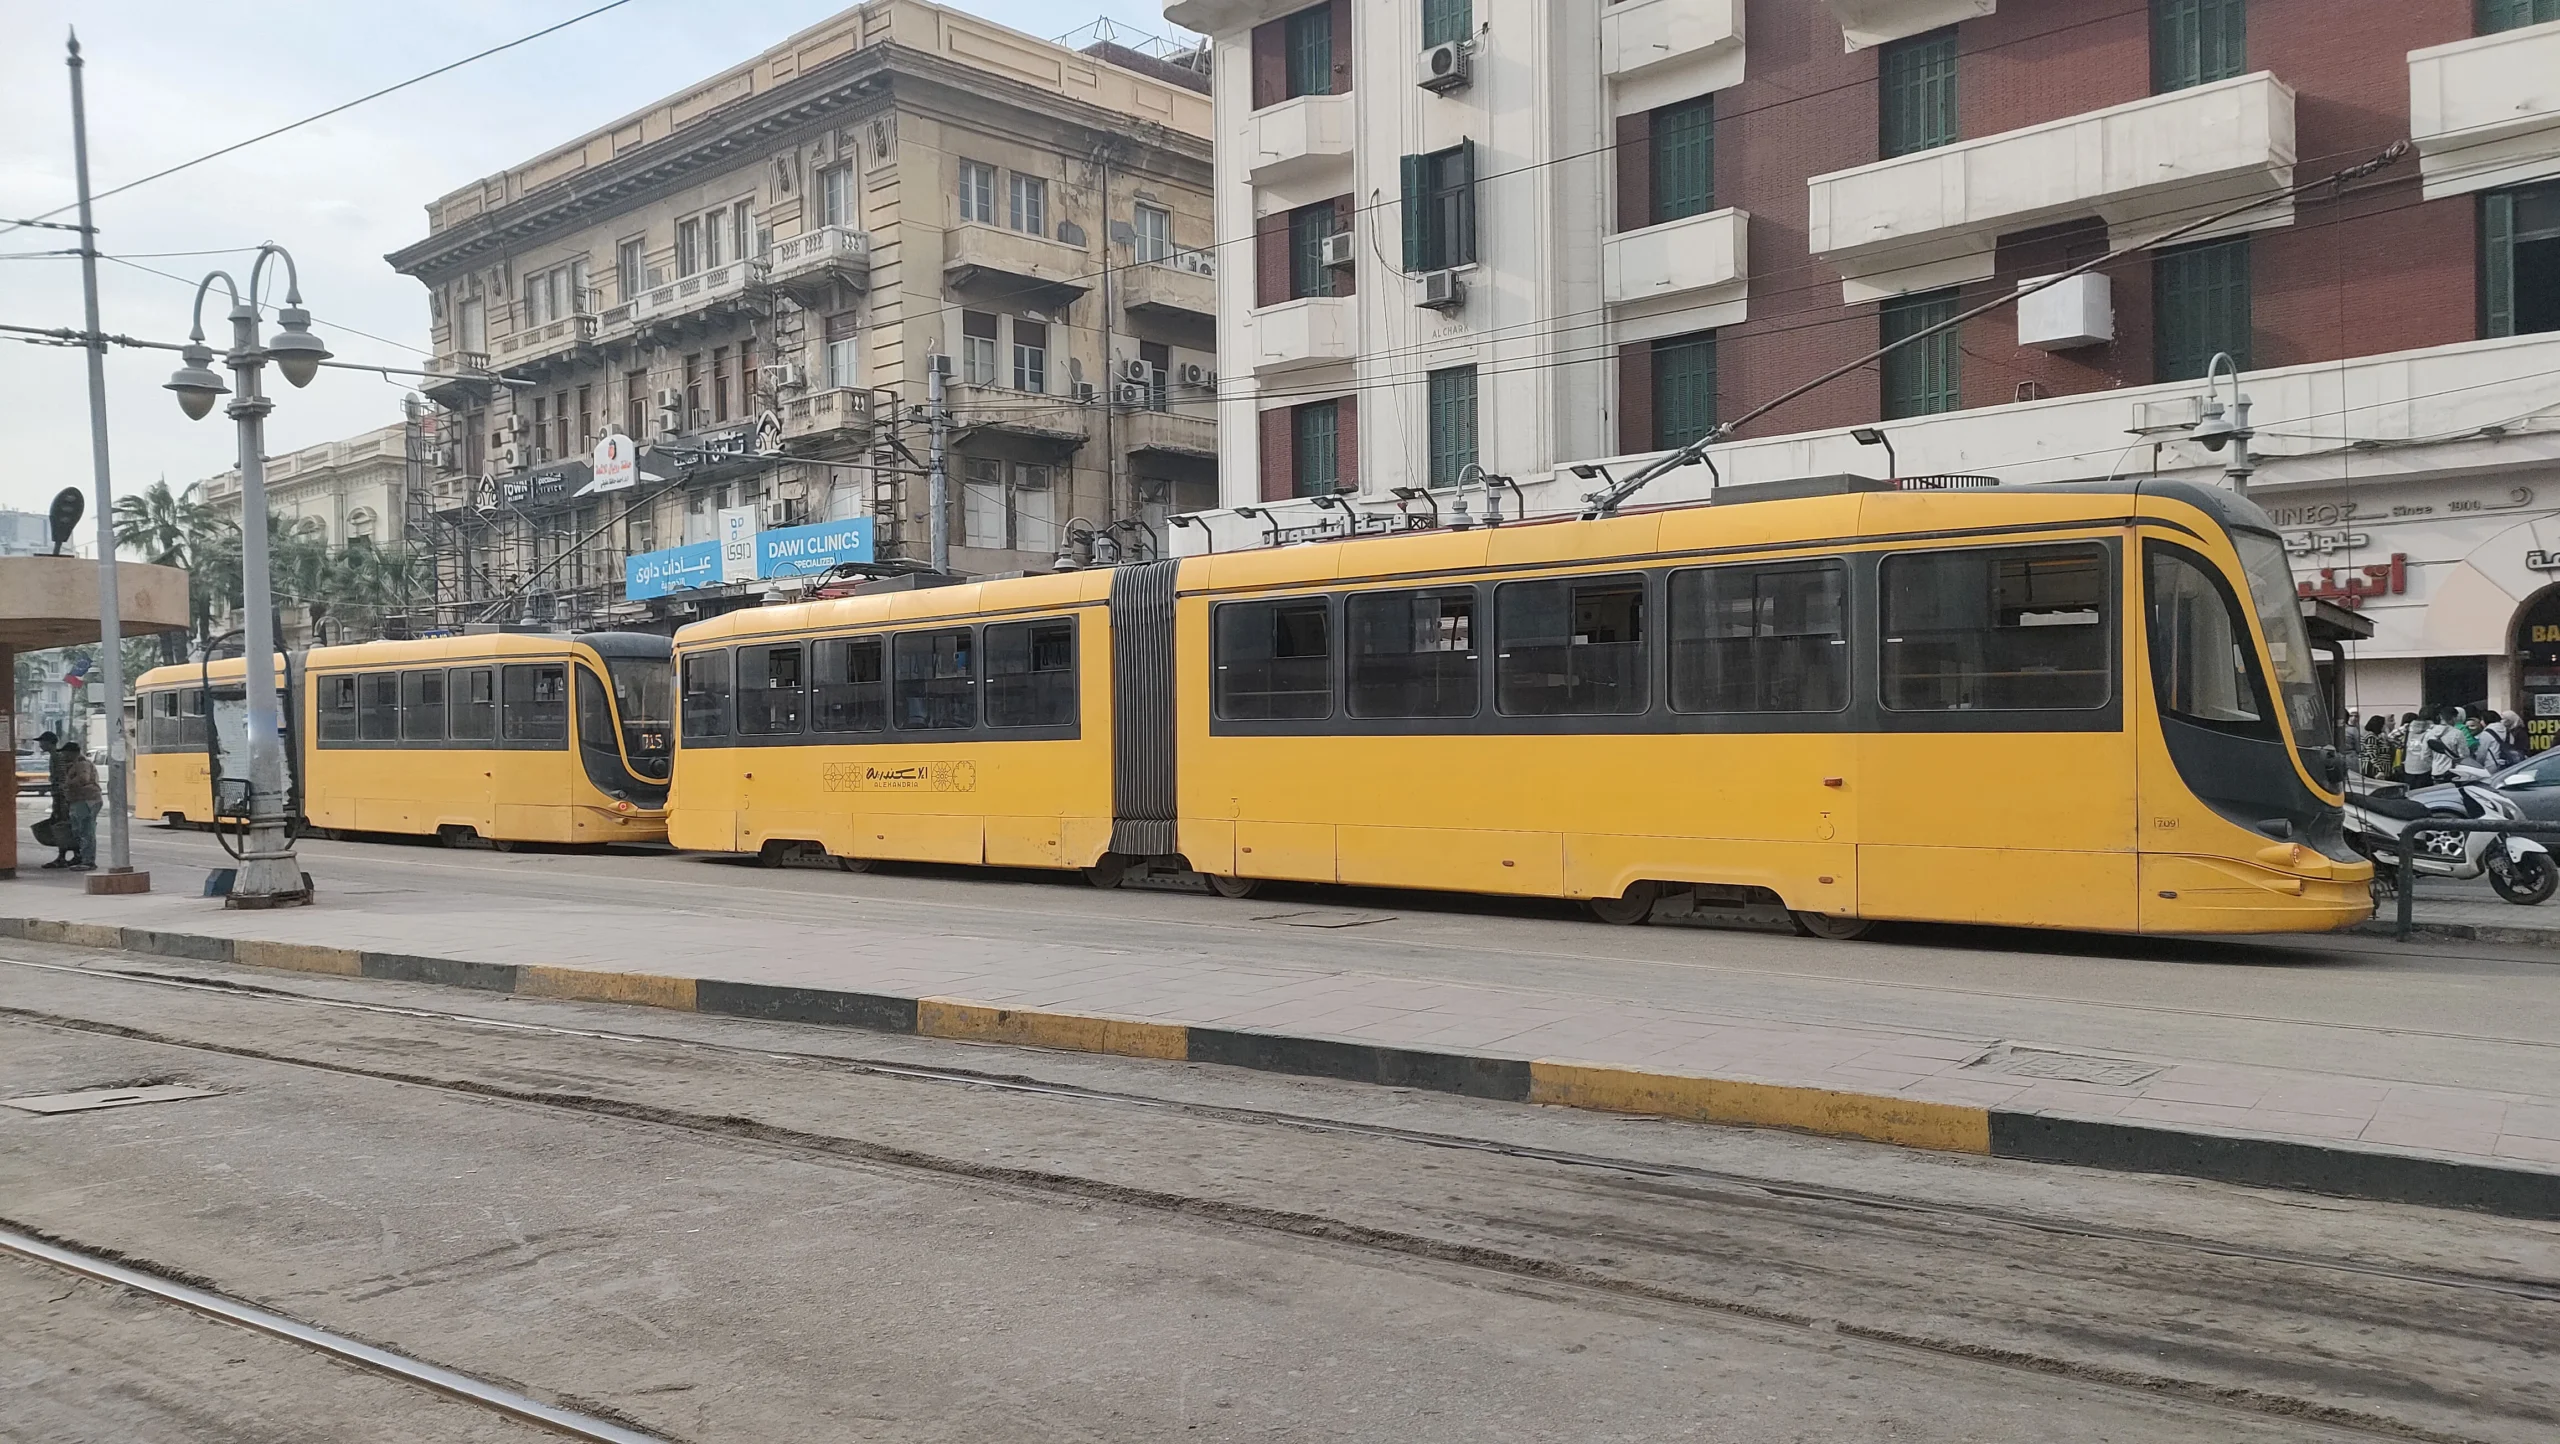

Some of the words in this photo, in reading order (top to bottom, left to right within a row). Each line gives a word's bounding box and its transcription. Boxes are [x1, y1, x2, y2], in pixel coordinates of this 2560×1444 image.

[503, 480, 528, 496] TOWN
[2393, 503, 2433, 516] Since
[2449, 500, 2481, 512] 1900
[768, 539, 804, 559] DAWI
[807, 531, 860, 554] CLINICS
[794, 556, 836, 569] SPECIALIZED
[642, 733, 663, 749] 715
[2529, 734, 2555, 750] NO
[2156, 819, 2176, 828] 709
